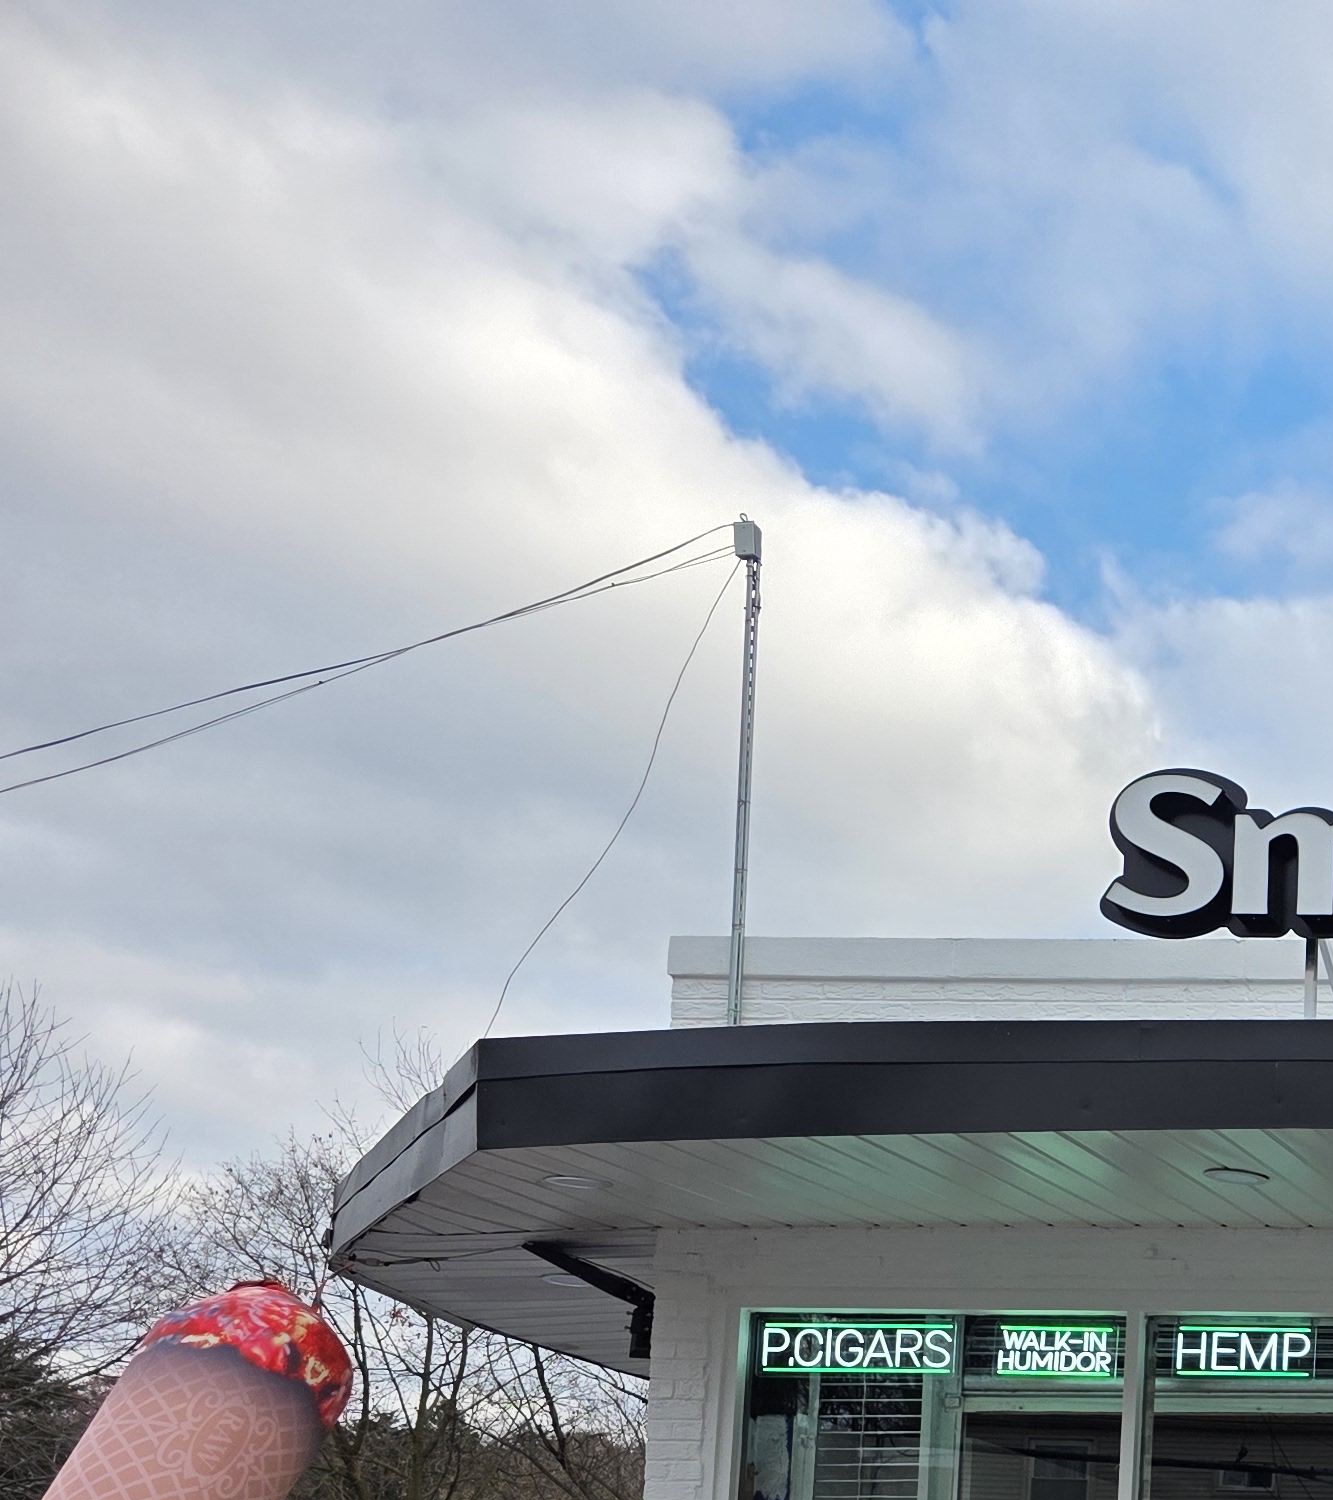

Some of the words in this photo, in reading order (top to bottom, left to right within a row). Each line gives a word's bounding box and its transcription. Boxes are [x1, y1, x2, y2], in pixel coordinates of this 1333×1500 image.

[1002, 1329, 1108, 1352] WALK-IN
[1176, 1331, 1312, 1371] HEMP
[997, 1350, 1112, 1373] HUMIDOR
[200, 1409, 246, 1473] RAW
